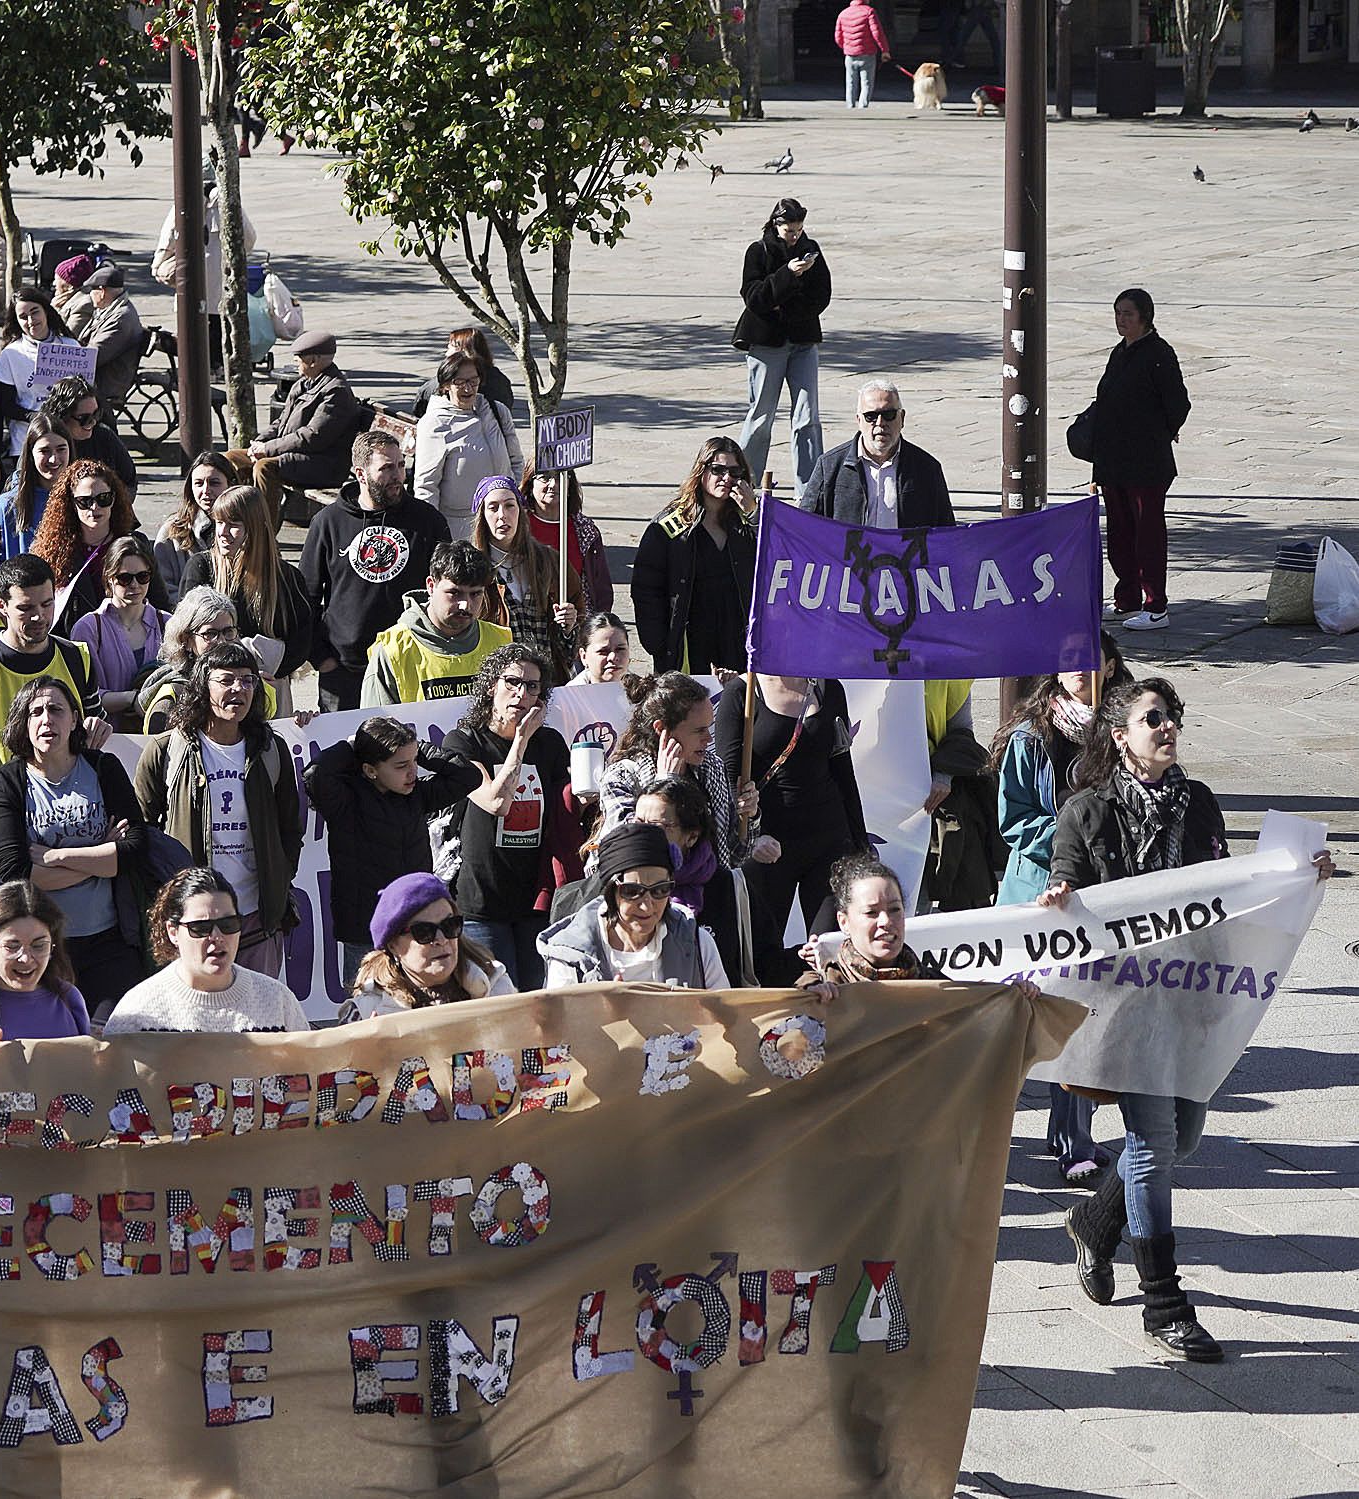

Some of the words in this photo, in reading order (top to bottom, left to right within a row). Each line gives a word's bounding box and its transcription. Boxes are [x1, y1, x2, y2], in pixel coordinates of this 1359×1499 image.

[49, 357, 89, 369] FUERTES
[51, 345, 88, 357] LIBRES
[365, 526, 408, 553] CULEBRA
[426, 683, 455, 699] 100%
[456, 682, 474, 696] ACT
[921, 938, 1003, 971] NON
[1023, 925, 1093, 962] VOS
[1105, 896, 1229, 950] TEMOS
[638, 1029, 701, 1097] E
[757, 1013, 828, 1081] O
[201, 1328, 275, 1428] E
[347, 1313, 520, 1418] EN
[571, 1258, 911, 1384] LOITA
